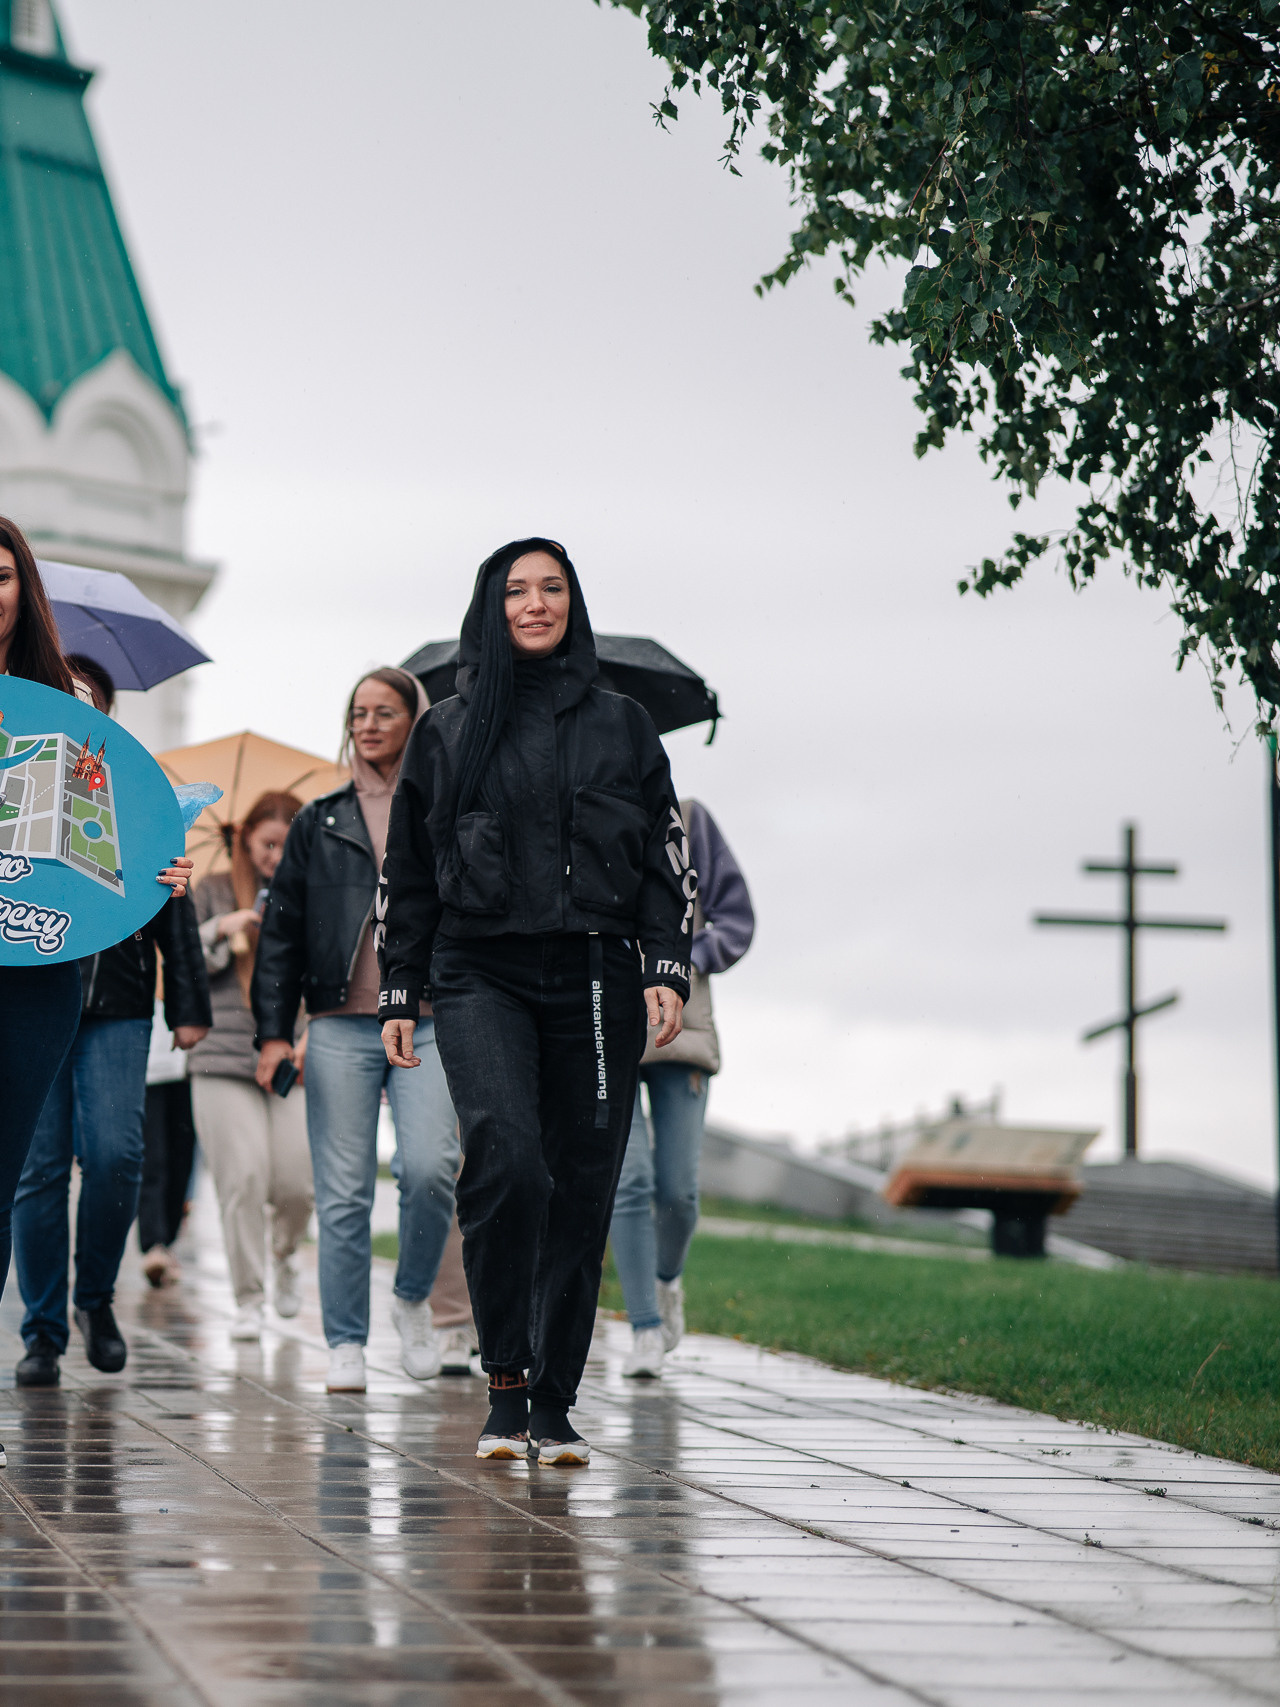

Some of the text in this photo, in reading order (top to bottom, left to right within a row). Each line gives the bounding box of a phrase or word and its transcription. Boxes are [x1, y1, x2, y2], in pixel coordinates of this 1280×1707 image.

[656, 959, 690, 984] ITAL
[390, 989, 407, 1005] IN
[591, 980, 608, 1100] alexanderwang
